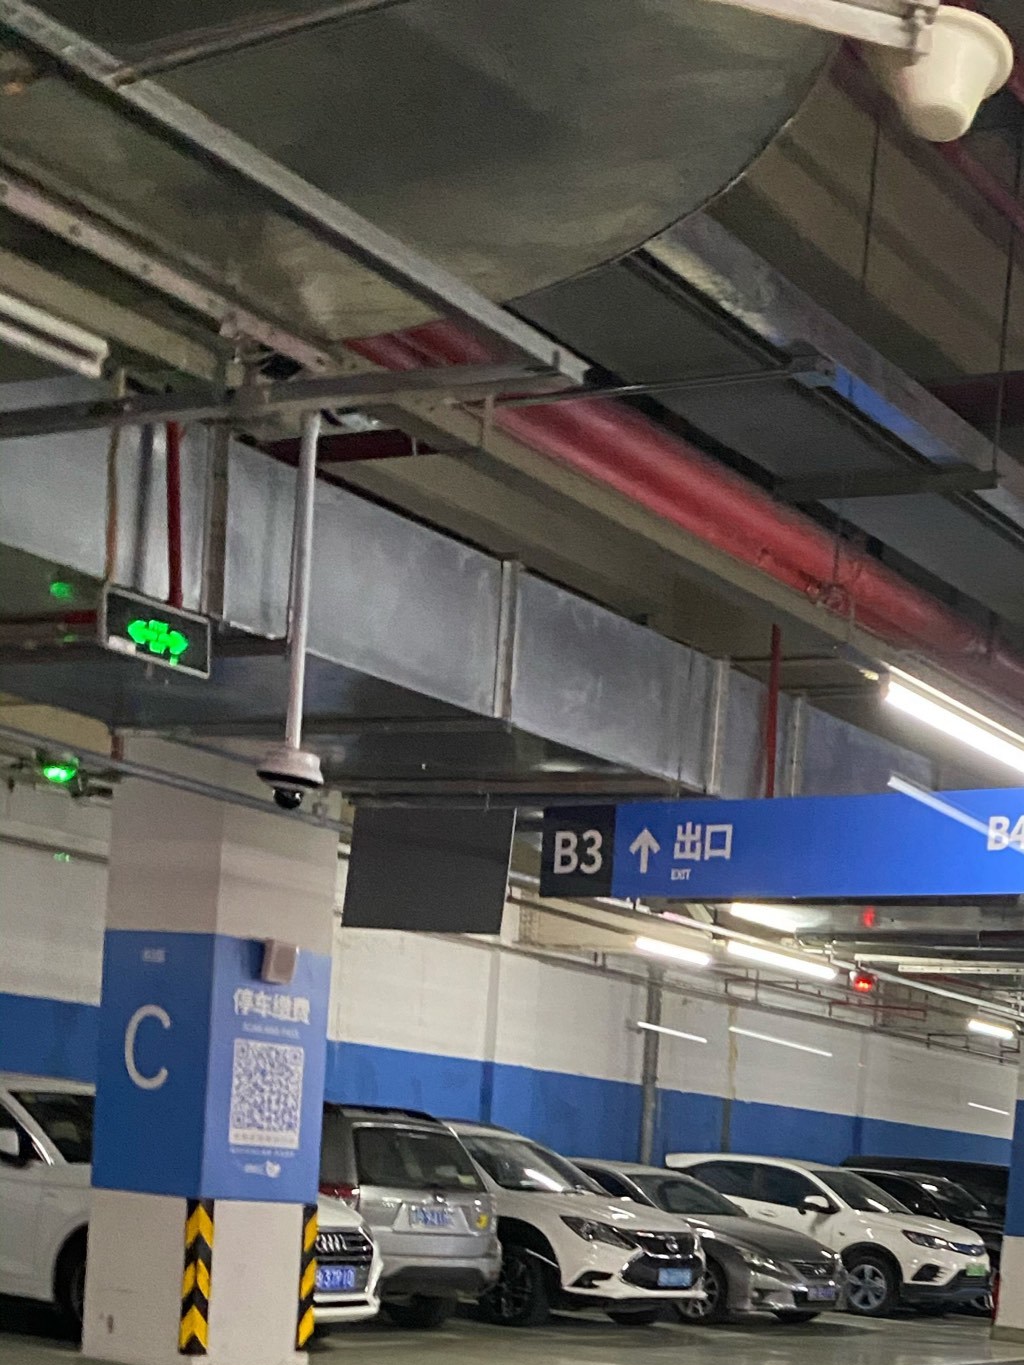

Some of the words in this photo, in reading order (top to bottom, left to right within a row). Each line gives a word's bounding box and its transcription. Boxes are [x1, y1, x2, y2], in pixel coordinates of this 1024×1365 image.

[553, 829, 603, 875] B3
[673, 821, 733, 861] 出口
[125, 1004, 171, 1090] C
